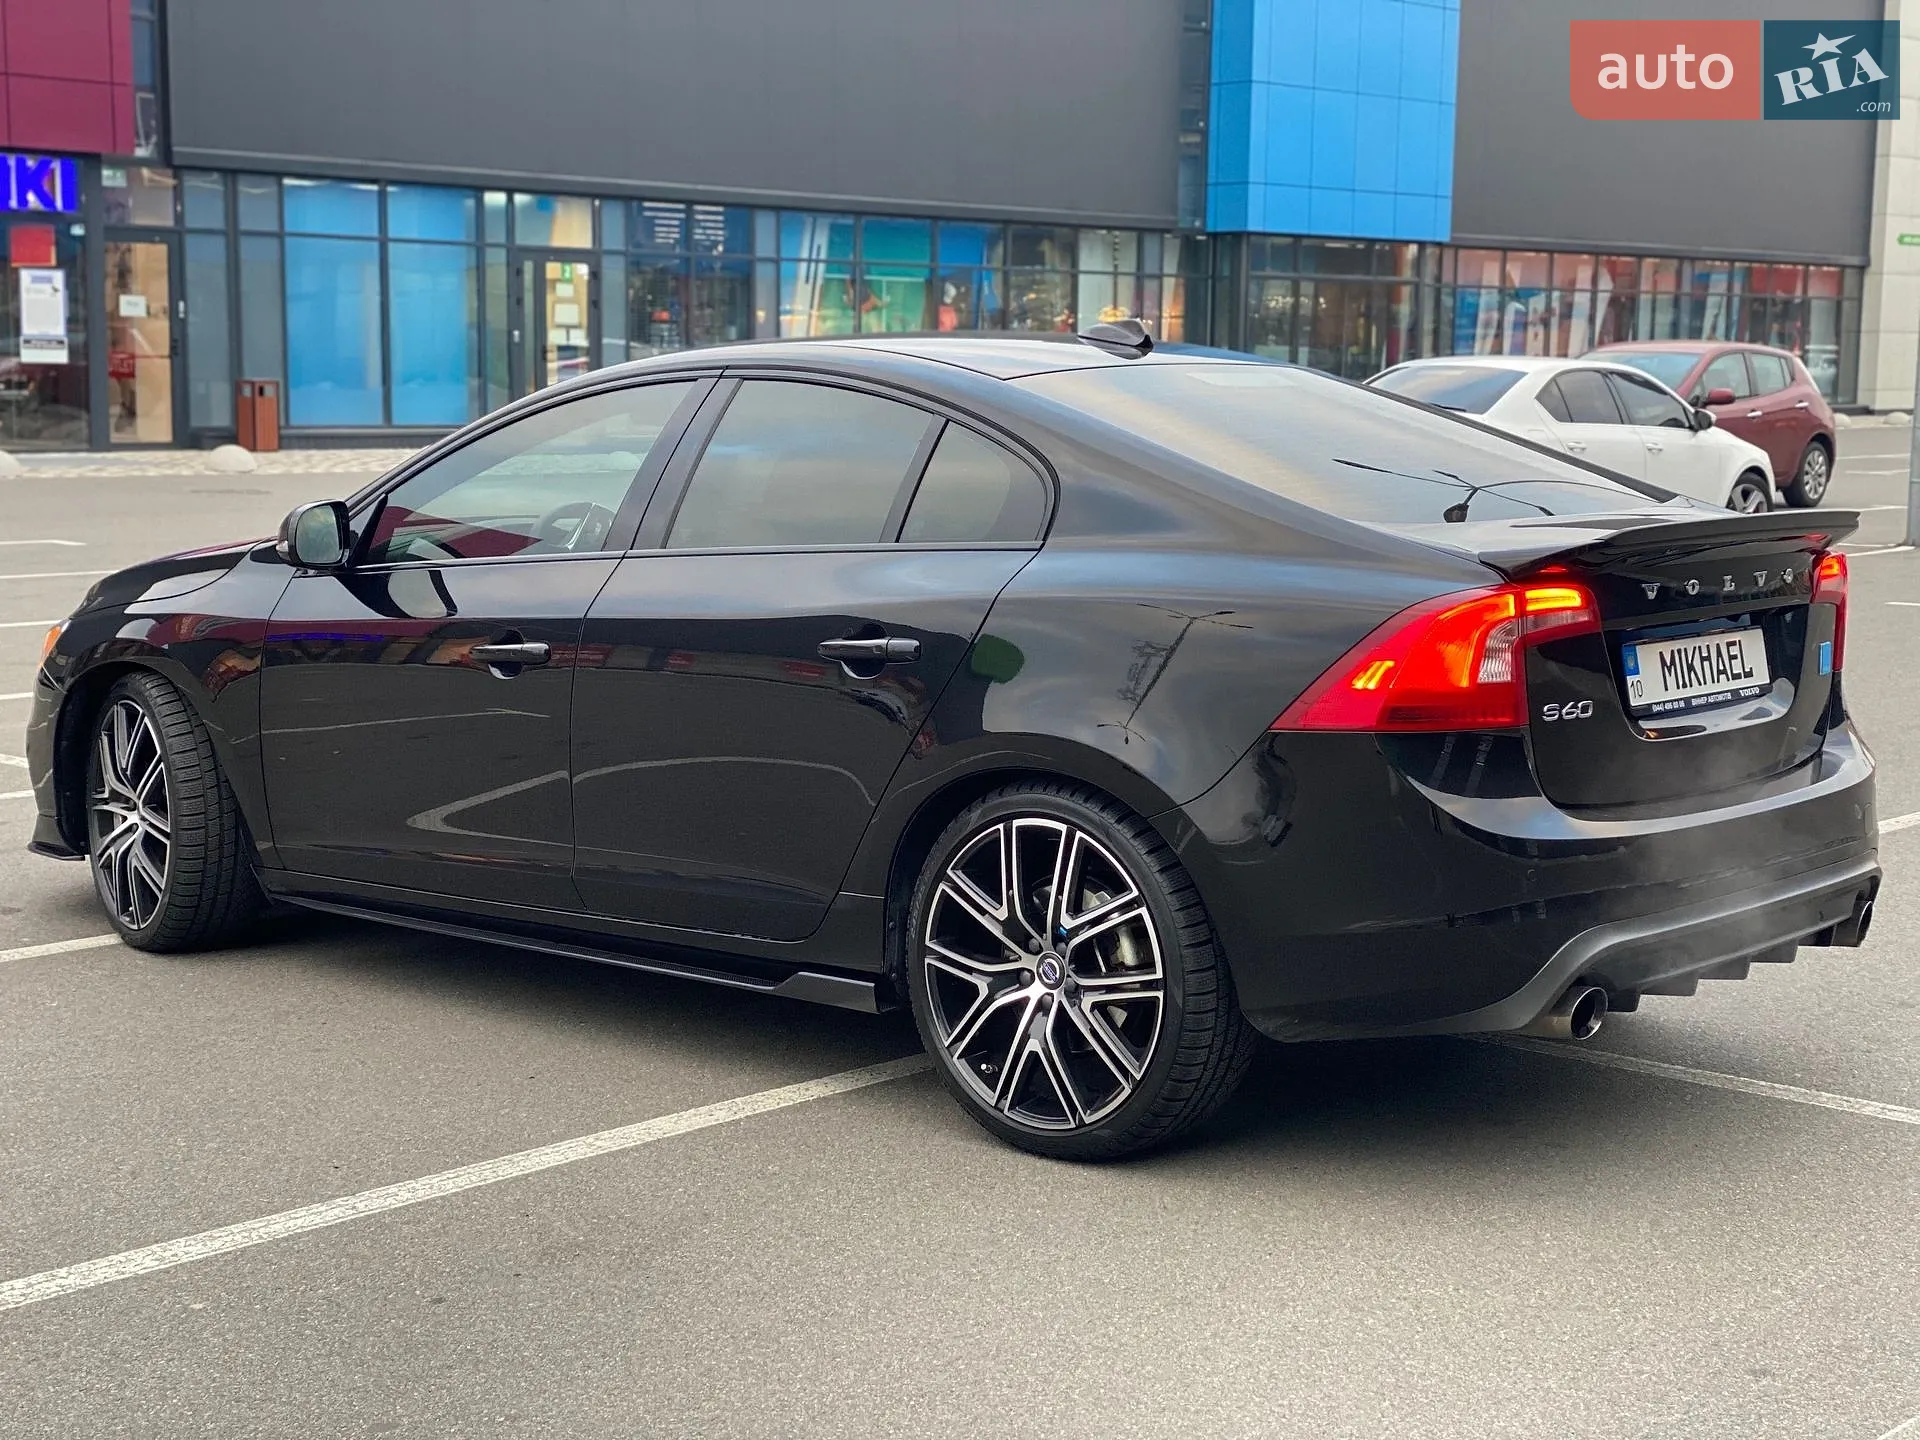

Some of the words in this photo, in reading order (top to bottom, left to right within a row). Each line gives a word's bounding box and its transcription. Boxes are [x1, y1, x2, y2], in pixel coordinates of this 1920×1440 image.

[1641, 568, 1794, 600] VOLVO
[1658, 639, 1754, 692] MIKHAEL
[1630, 679, 1644, 698] 10
[1739, 686, 1760, 697] VOLVO
[1542, 700, 1593, 721] S60
